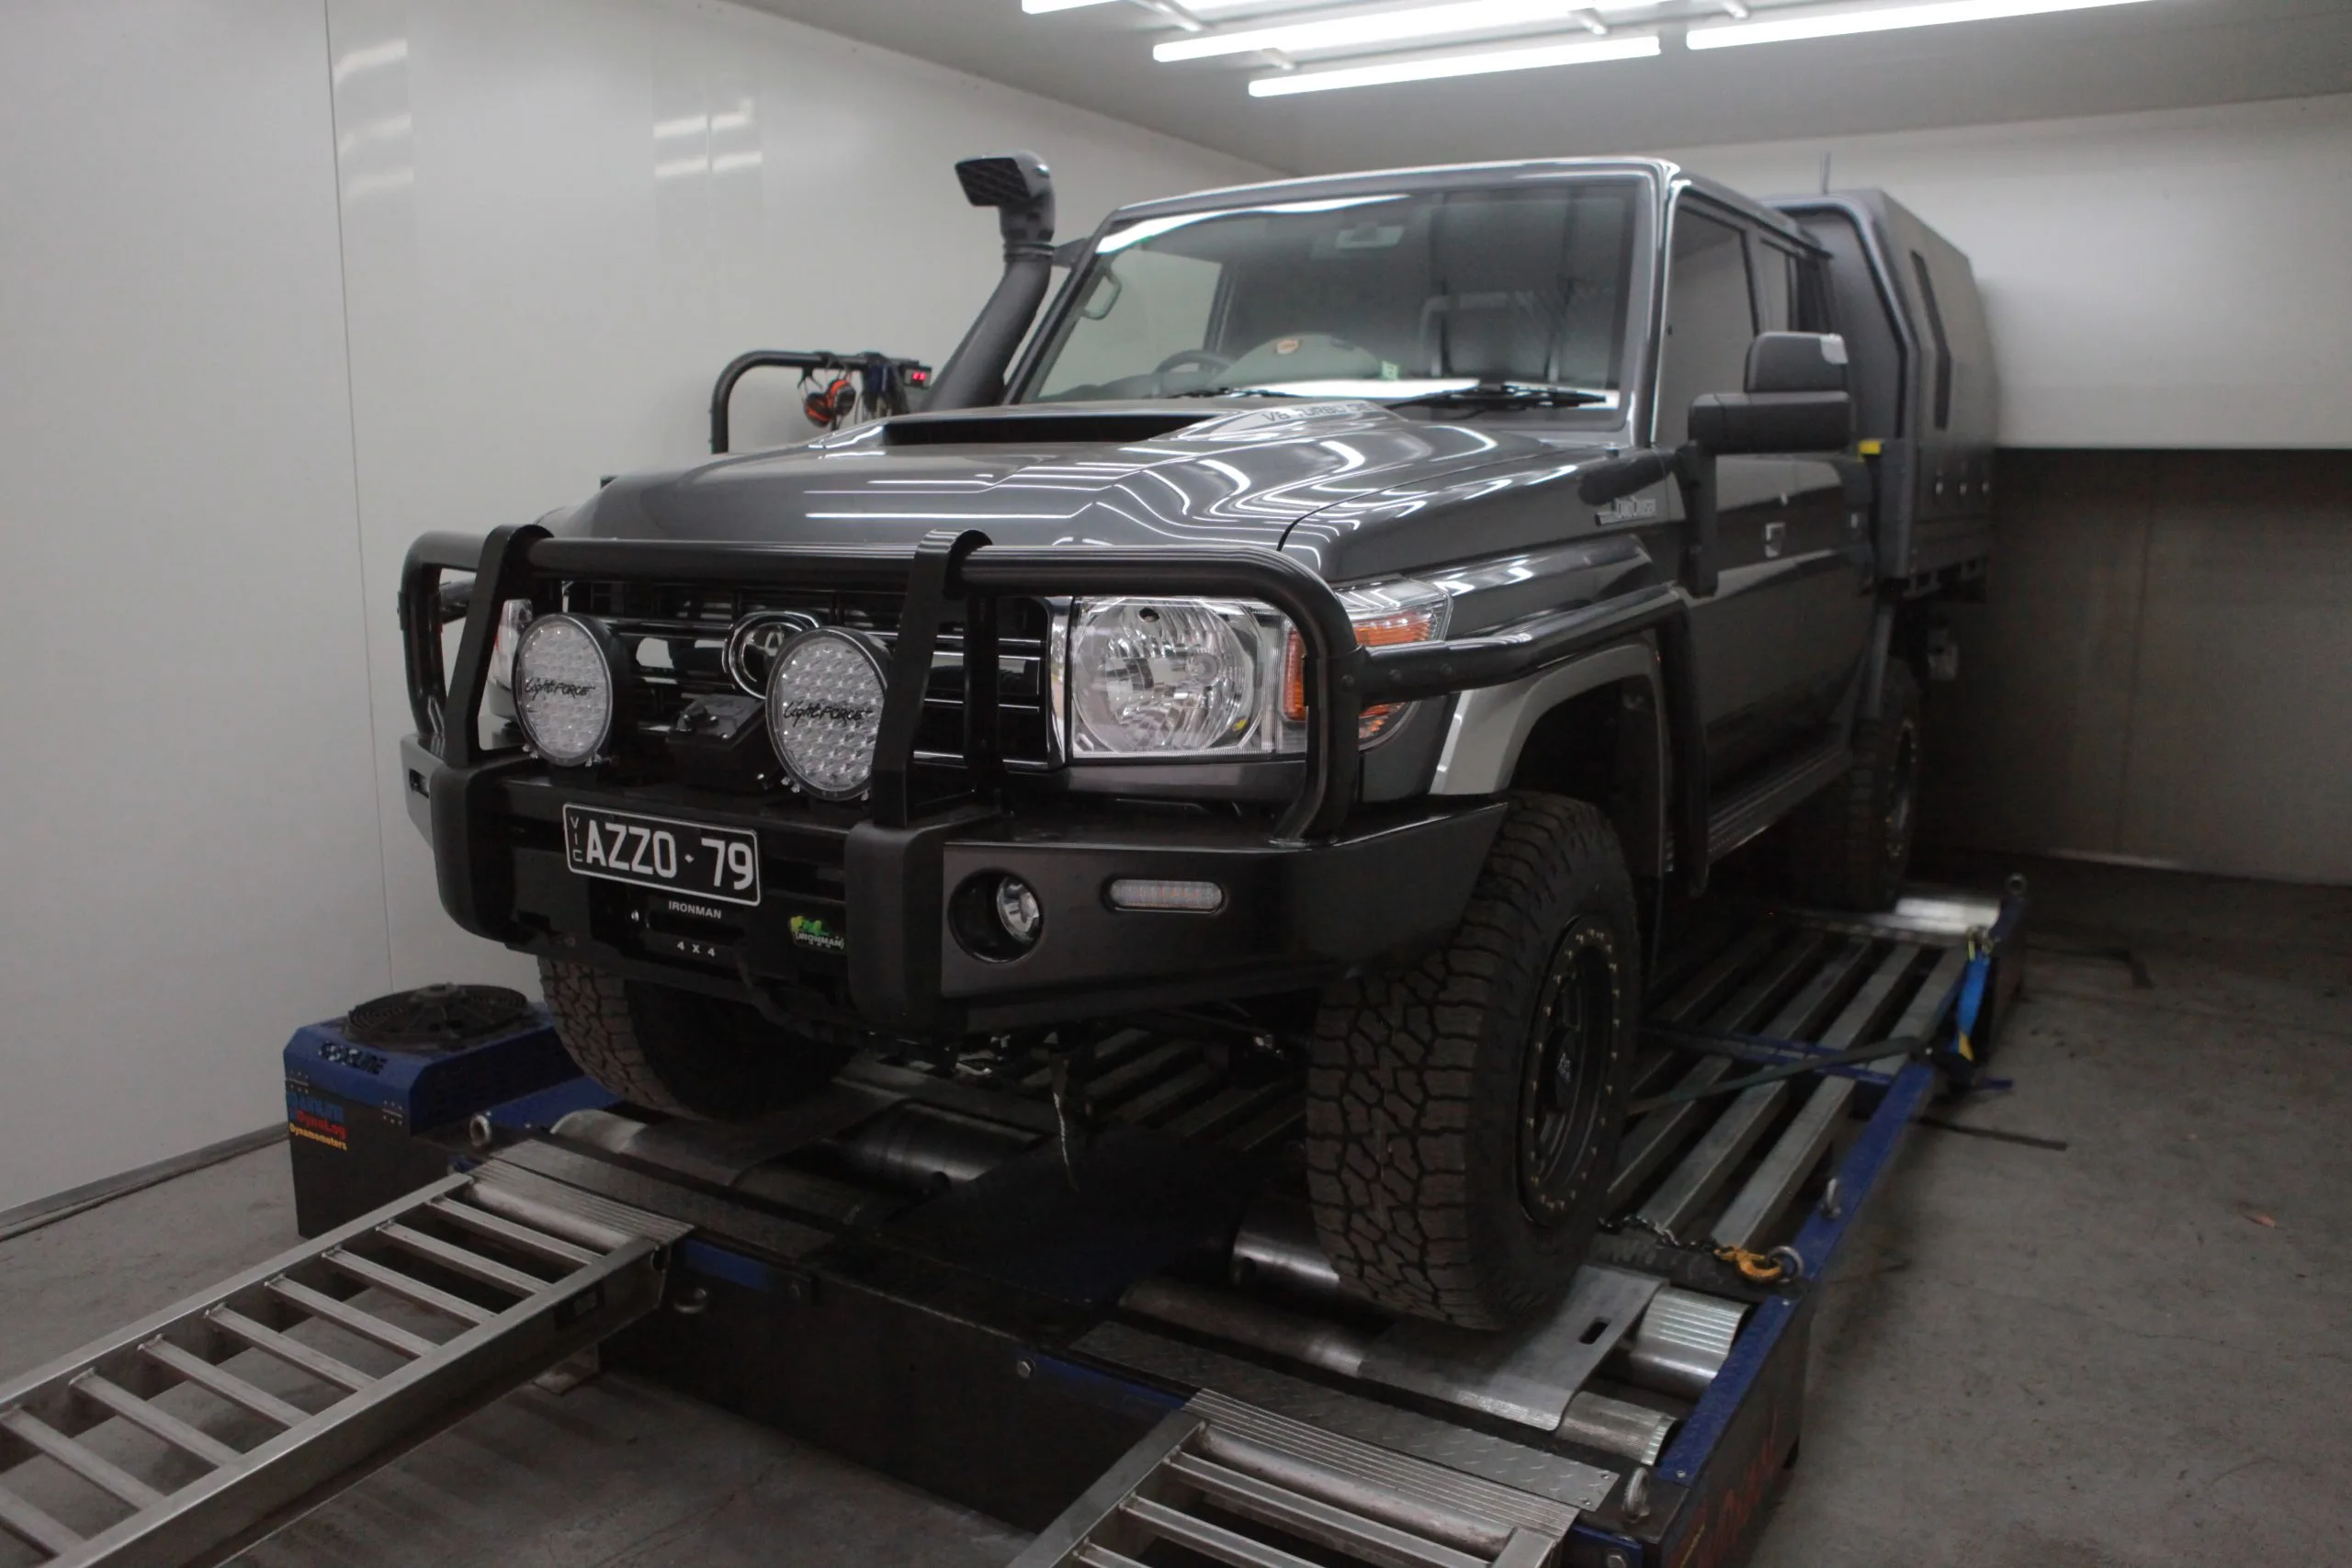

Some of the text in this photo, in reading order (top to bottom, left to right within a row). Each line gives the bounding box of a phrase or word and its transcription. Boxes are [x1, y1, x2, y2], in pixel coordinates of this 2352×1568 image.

[570, 817, 583, 863] VIC
[668, 900, 722, 919] IRONMAN
[288, 1122, 348, 1152] Dynamometers
